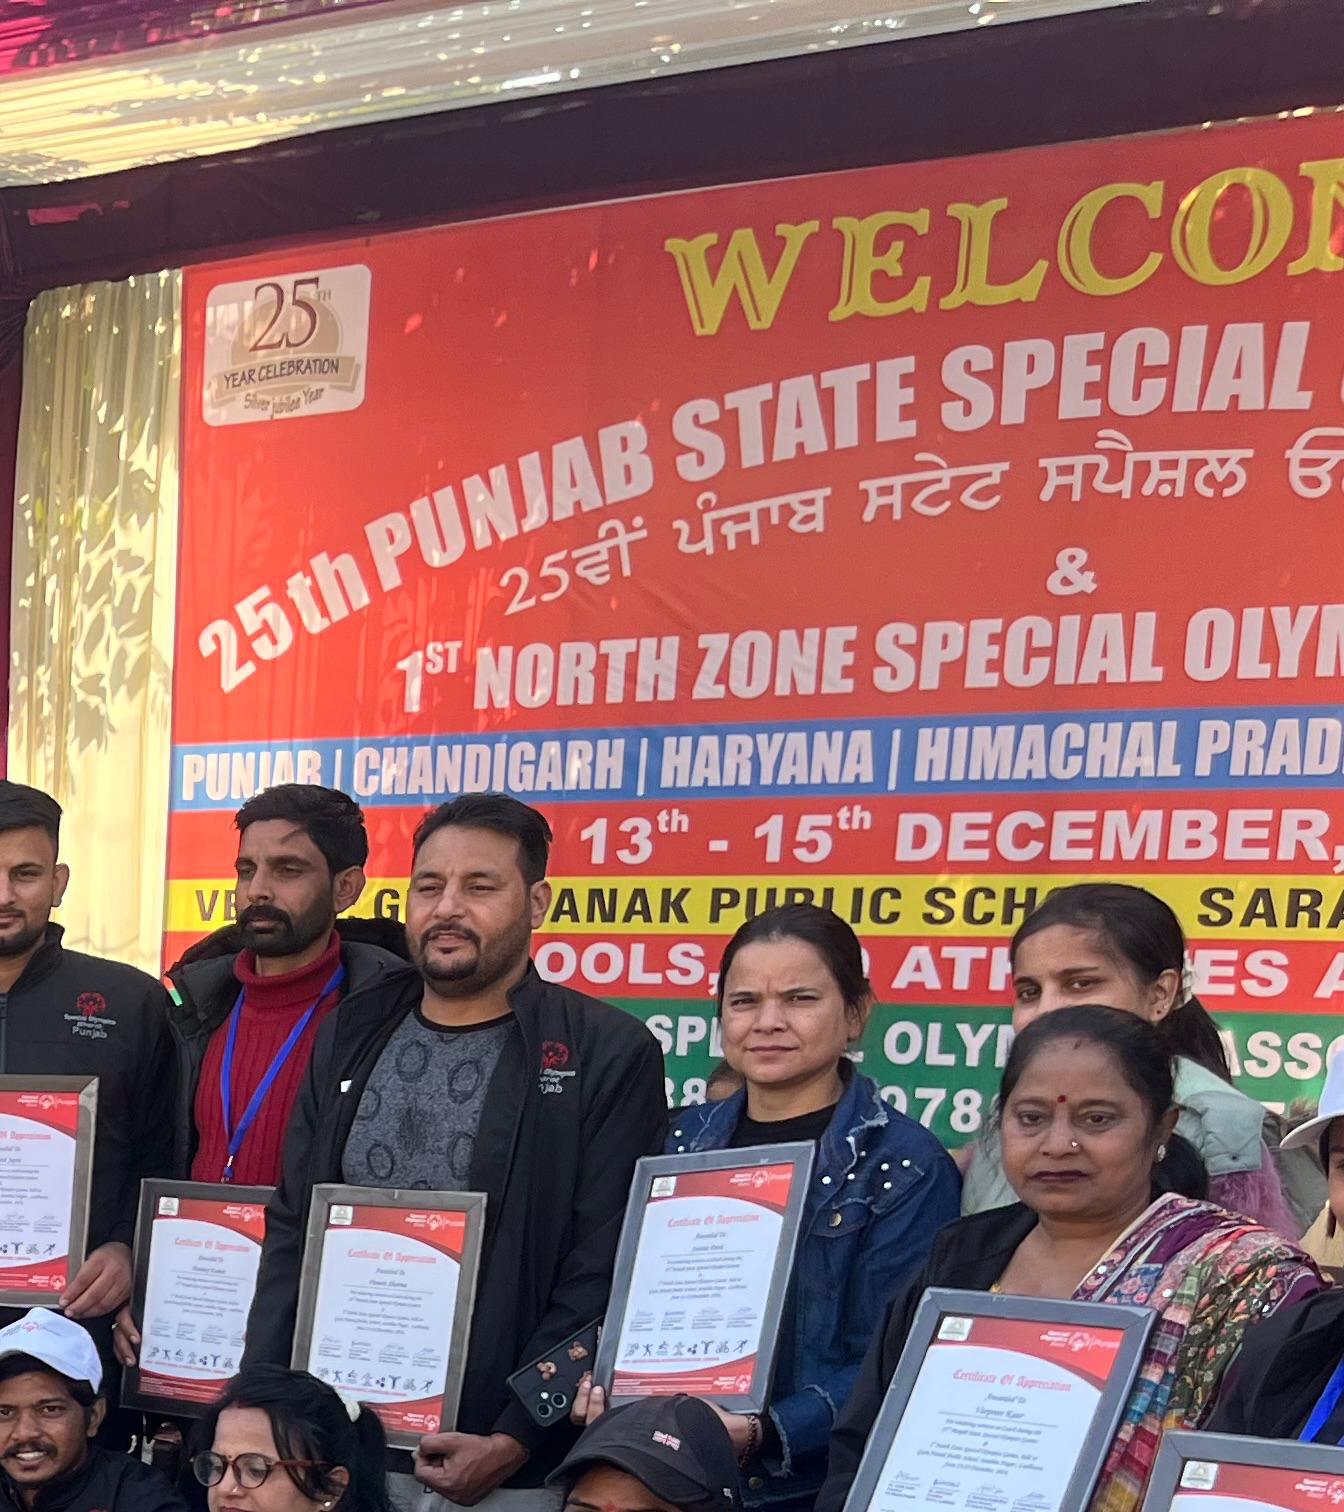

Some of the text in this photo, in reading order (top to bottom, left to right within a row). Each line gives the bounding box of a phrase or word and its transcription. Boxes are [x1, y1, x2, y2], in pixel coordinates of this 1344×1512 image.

[249, 277, 319, 352] 25
[223, 358, 340, 389] YEAR CELEBRATION
[198, 320, 1313, 695] 25th PUNJAB STATE SPECIAL
[671, 486, 832, 557] ਪੰਜਾਬ
[859, 451, 1010, 522] ਸਟੇਟ
[1046, 546, 1098, 596] &
[396, 640, 464, 713] 1ST
[473, 634, 680, 710] NORTH
[692, 625, 858, 700] ZONE
[873, 611, 1164, 693] SPECIAL
[182, 747, 322, 801] PUNJAB
[353, 736, 627, 797] CHANDIGARH
[660, 729, 874, 789] HARYANA
[913, 721, 1182, 783] HIMACHAL
[1194, 718, 1344, 777] PRAD
[579, 806, 691, 867] 13th
[753, 802, 872, 864] 15th
[550, 887, 692, 924] ANAK
